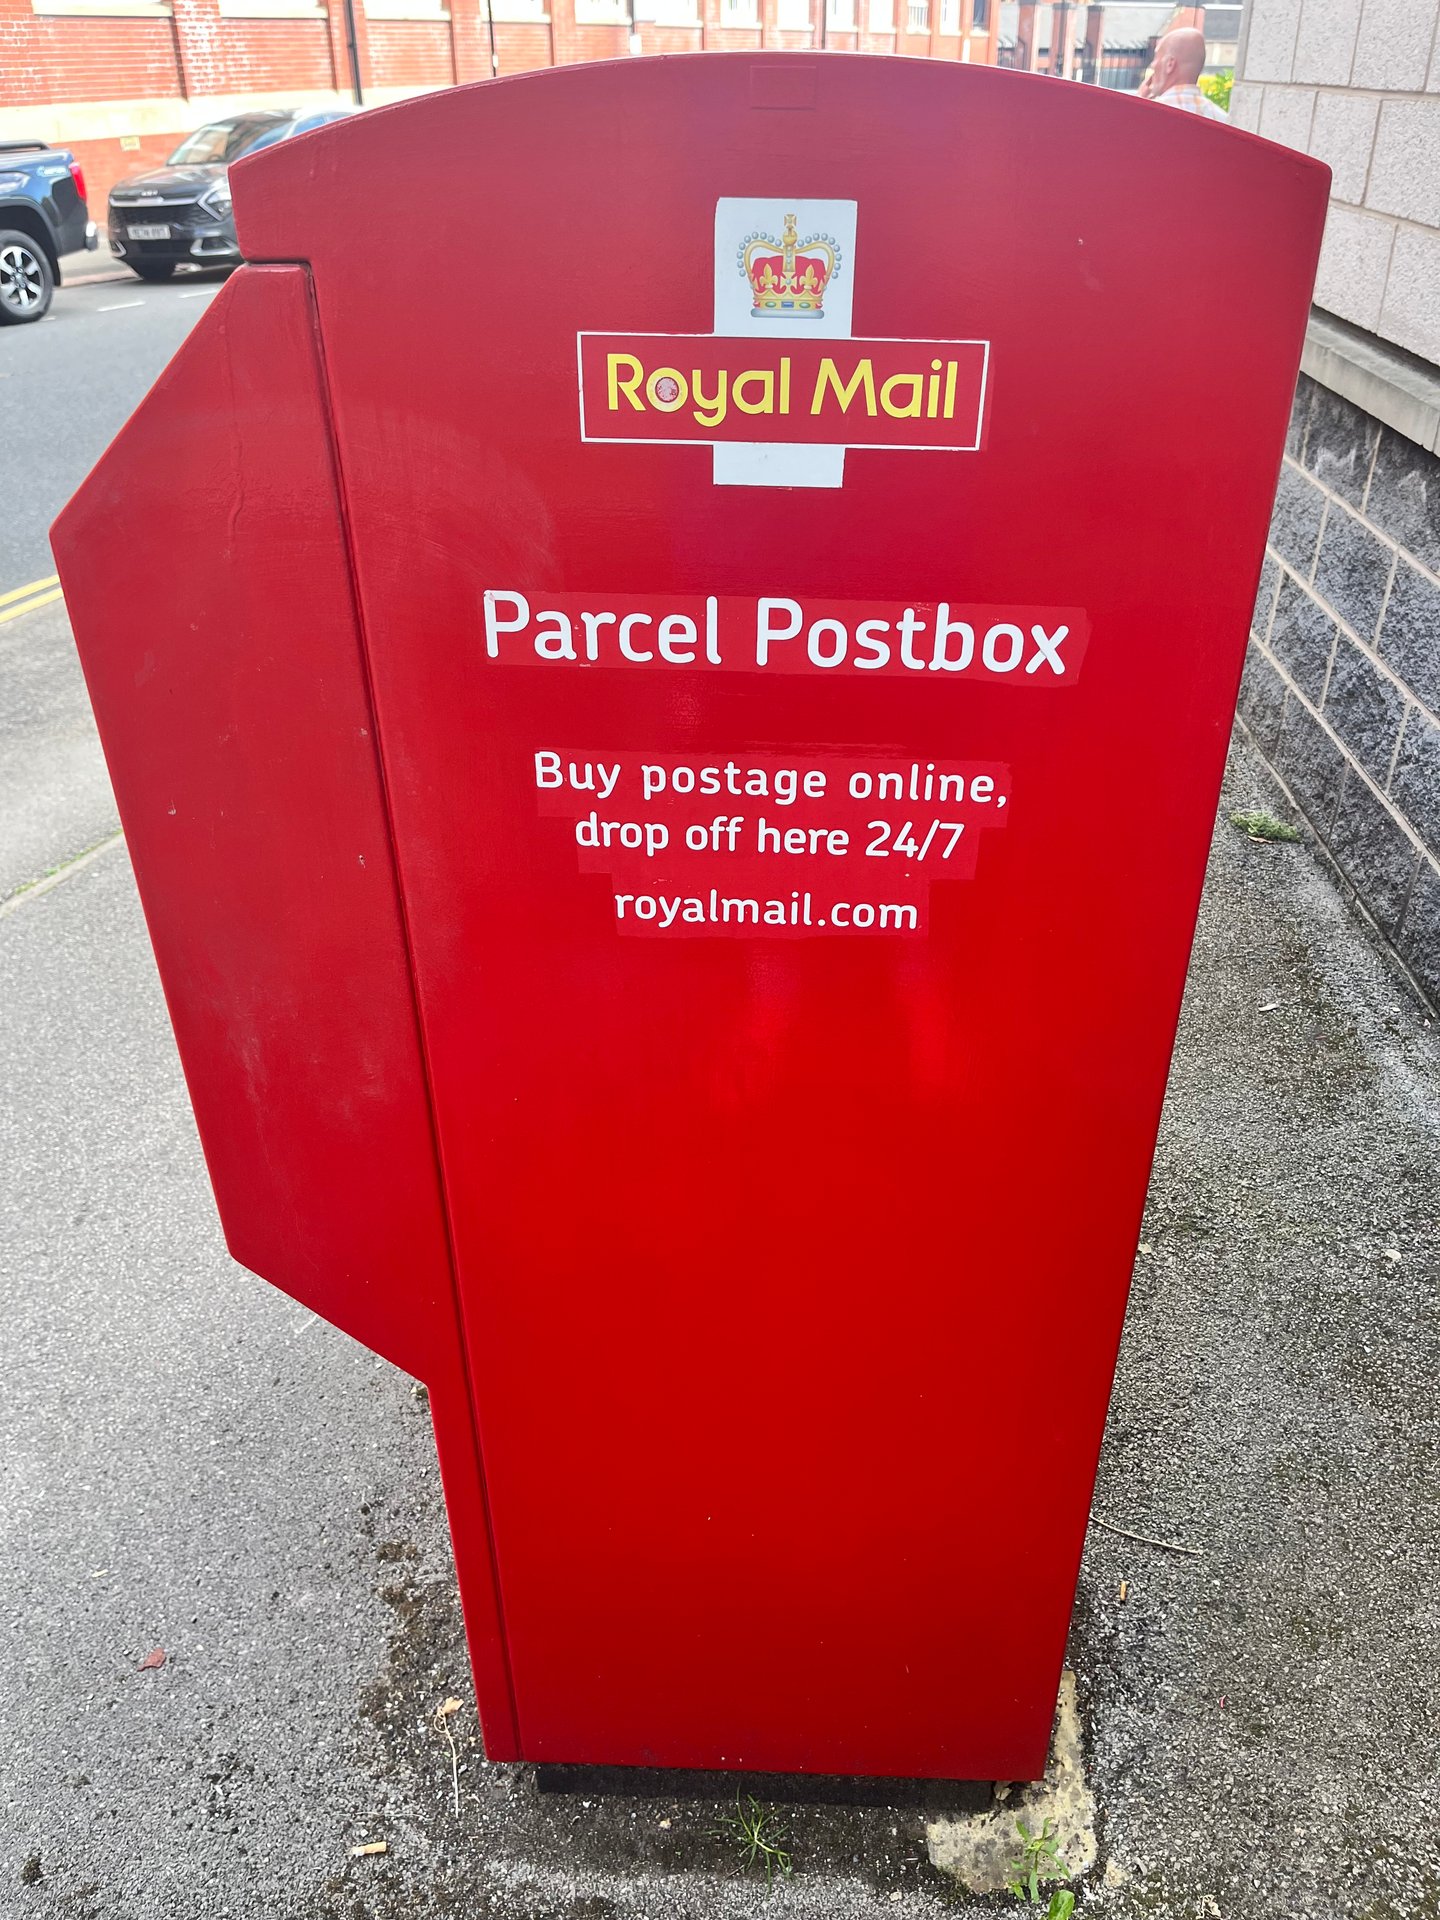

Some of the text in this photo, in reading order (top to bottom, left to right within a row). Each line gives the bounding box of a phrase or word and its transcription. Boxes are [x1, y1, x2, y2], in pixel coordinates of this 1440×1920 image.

[606, 353, 959, 427] Royal Mail
[483, 589, 1070, 675] Parcel Postbox
[534, 751, 1007, 809] Buy postage online,
[575, 811, 965, 861] drop off here 24/7
[614, 888, 918, 930] royalmail.com
